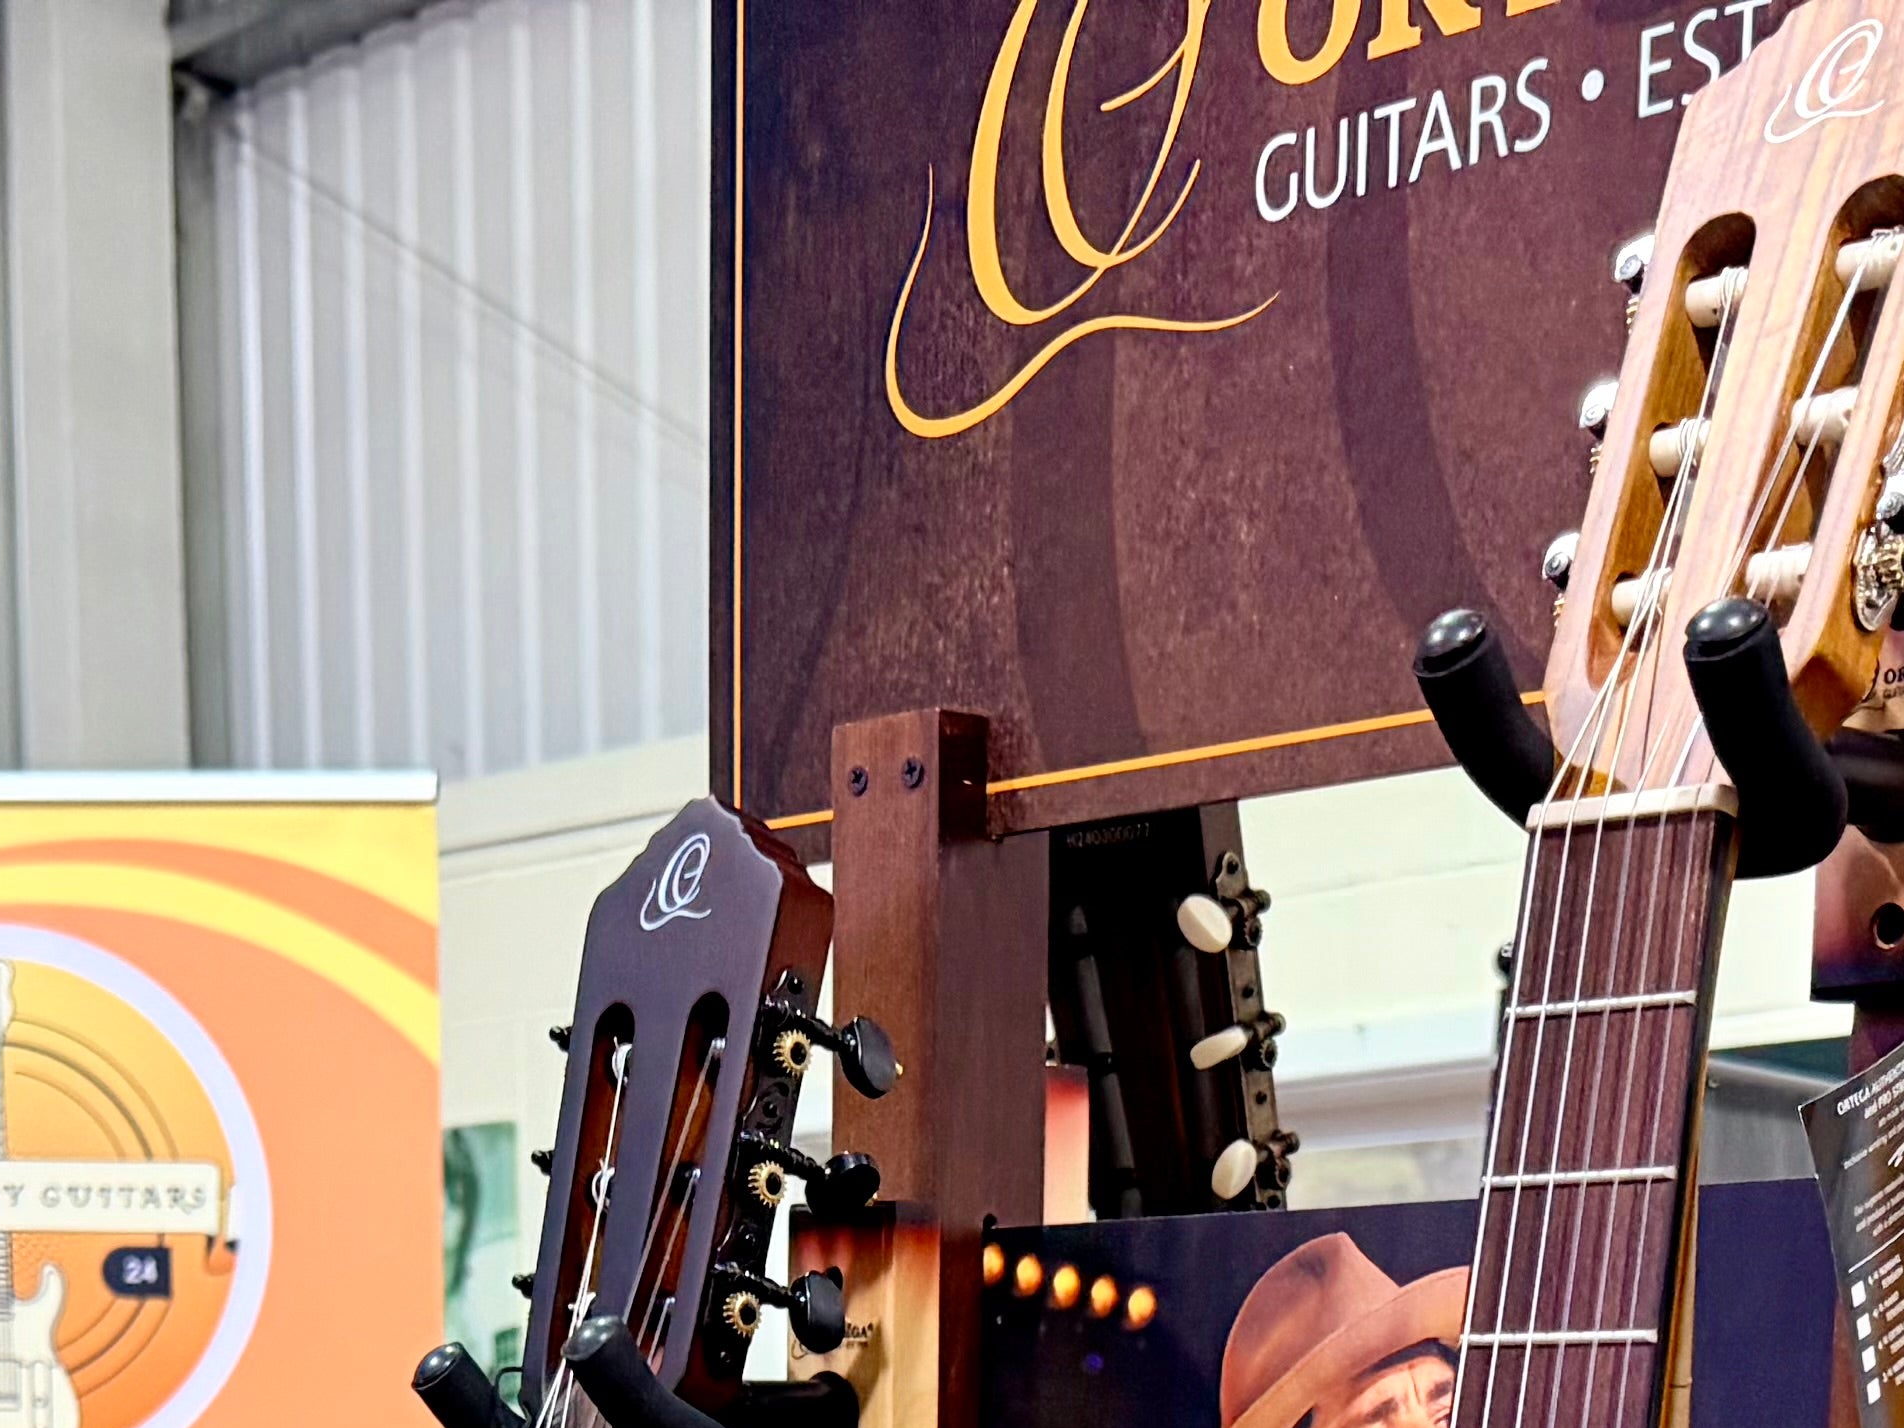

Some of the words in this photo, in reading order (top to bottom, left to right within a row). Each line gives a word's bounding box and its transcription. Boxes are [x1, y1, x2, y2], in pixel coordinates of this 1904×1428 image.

[1254, 57, 1552, 223] GUITARS
[39, 1183, 208, 1215] GUITARS
[121, 1255, 159, 1286] 24
